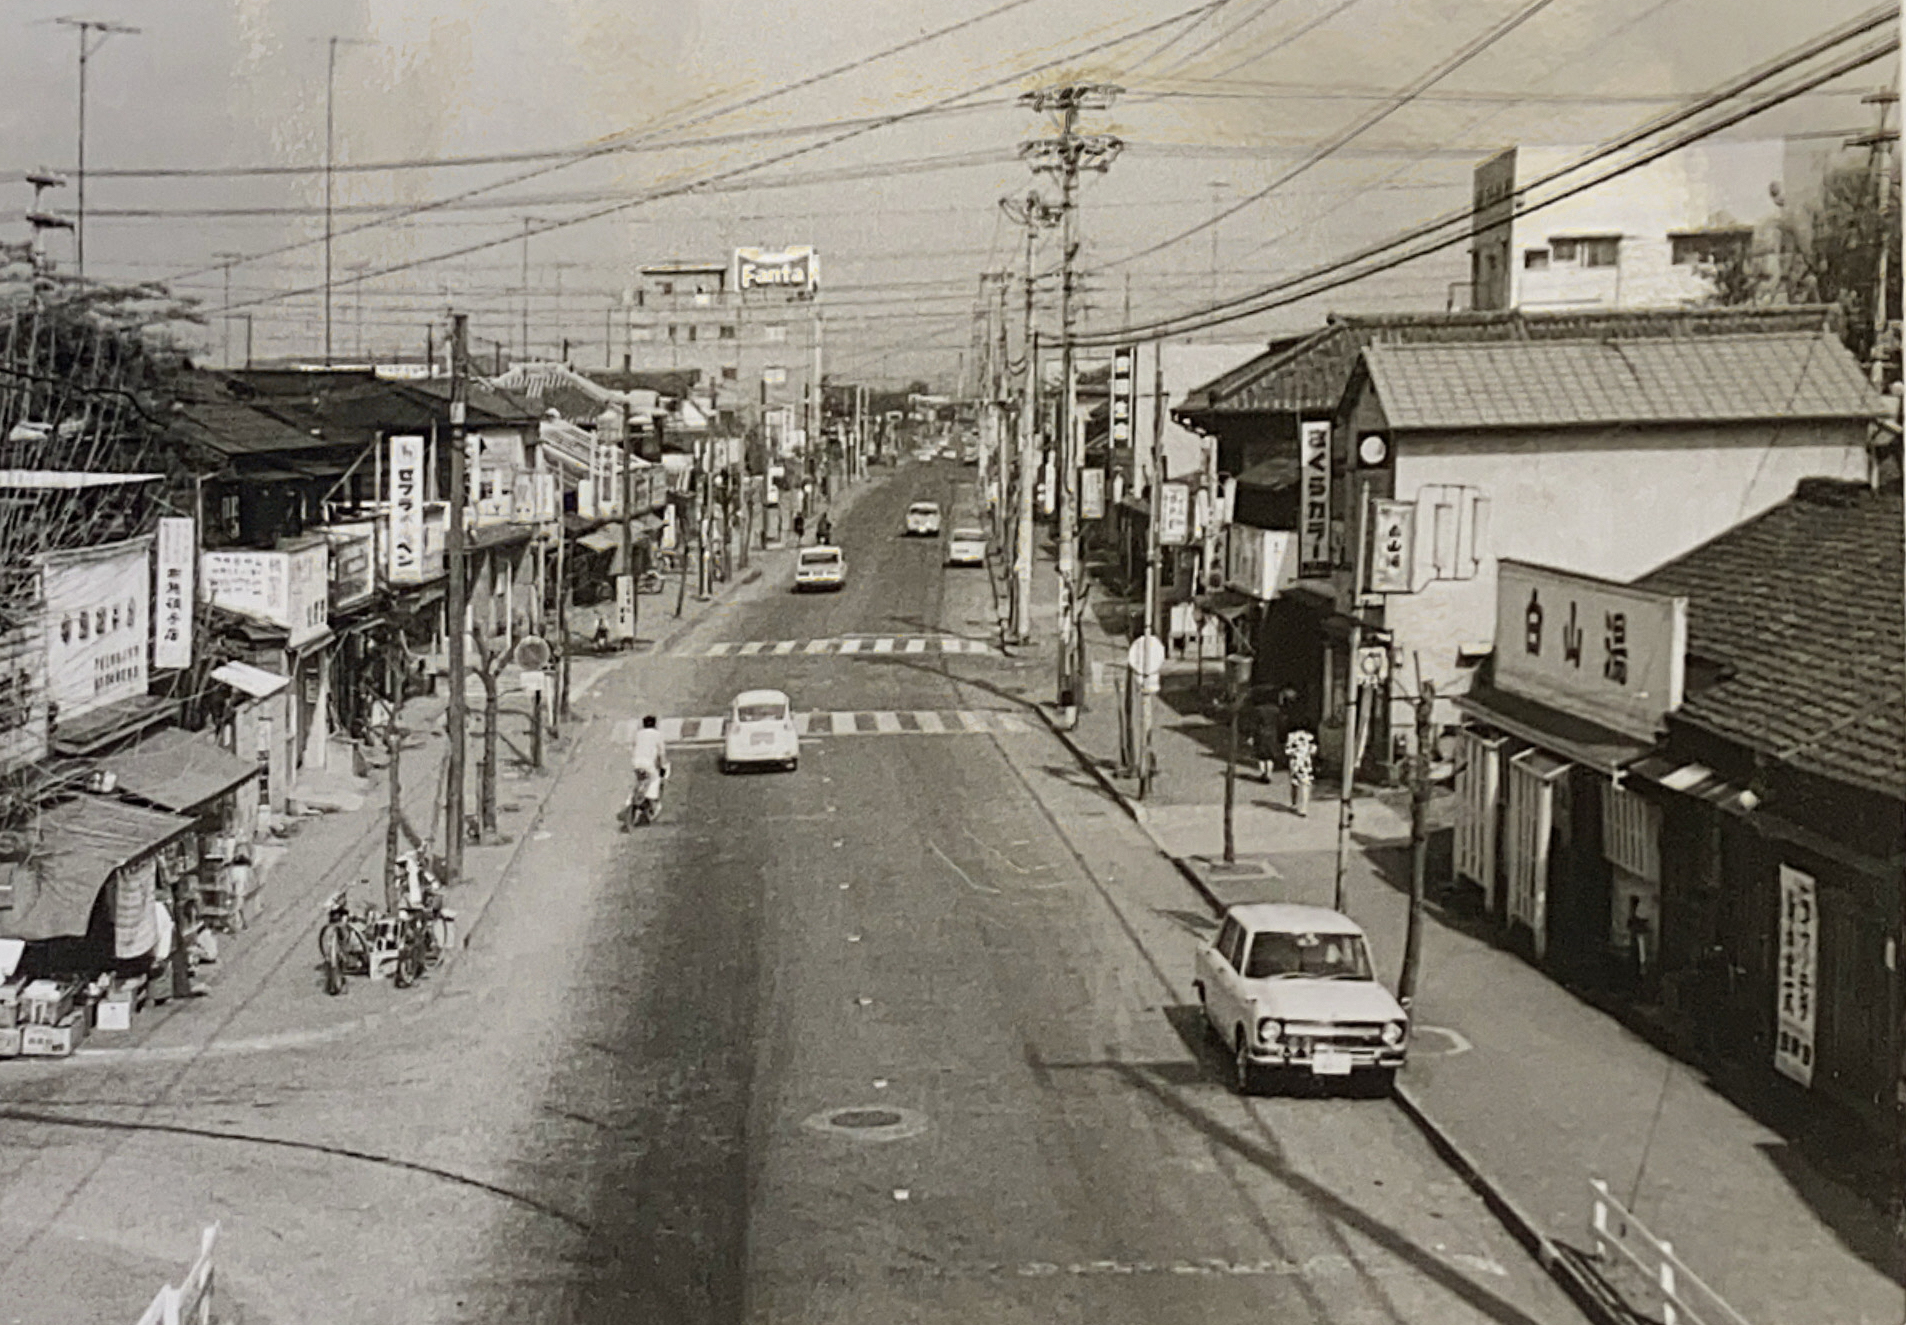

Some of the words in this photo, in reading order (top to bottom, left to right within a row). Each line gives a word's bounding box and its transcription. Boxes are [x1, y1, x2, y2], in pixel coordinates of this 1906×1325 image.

[742, 264, 805, 289] Fanta
[1307, 428, 1327, 560] さくらカラー
[1526, 587, 1629, 686] 白山湯
